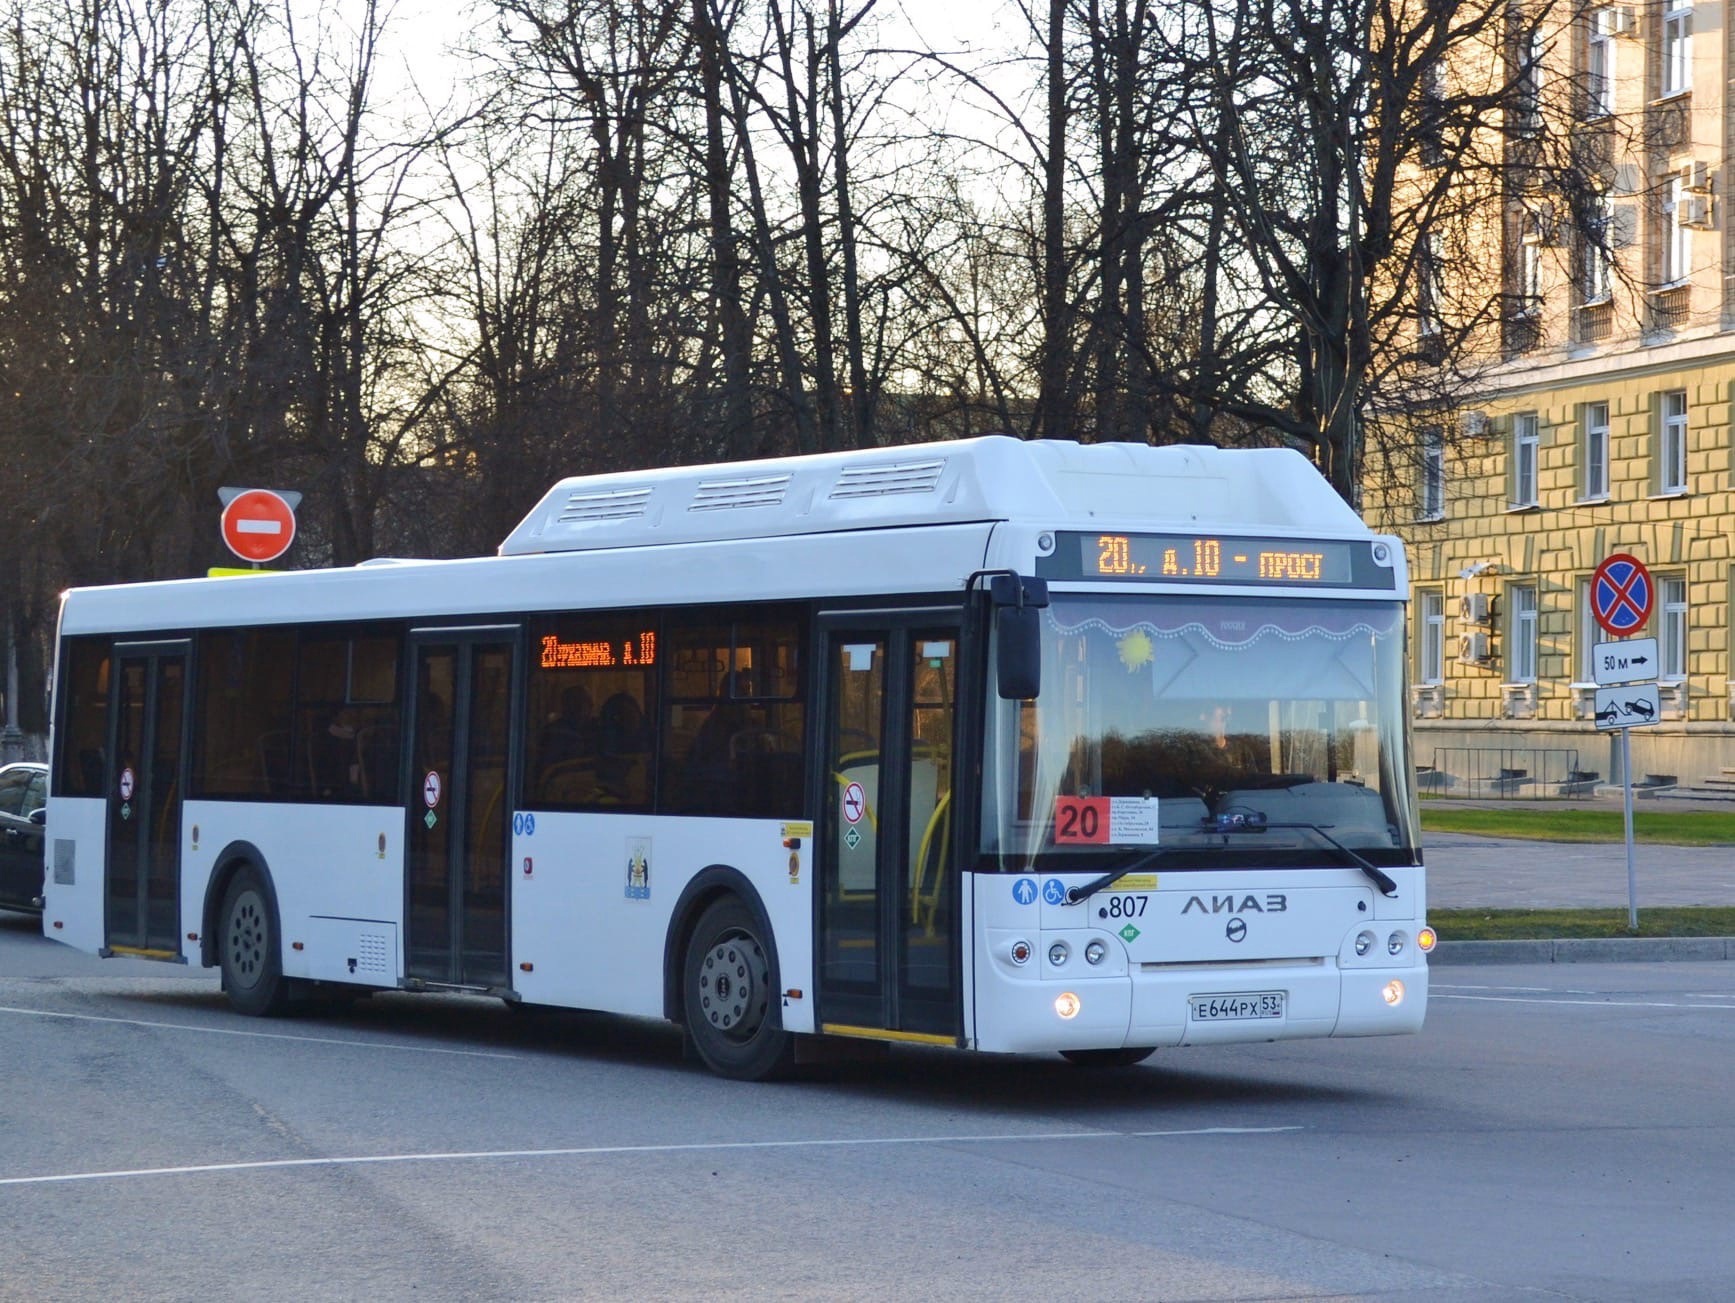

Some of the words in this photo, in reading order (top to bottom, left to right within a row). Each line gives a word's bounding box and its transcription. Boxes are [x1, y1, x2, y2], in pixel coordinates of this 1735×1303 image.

[1604, 655, 1615, 671] 50
[1060, 805, 1099, 838] 20
[1109, 896, 1148, 918] 807
[1181, 894, 1287, 915] ЛИАЗ
[1262, 996, 1276, 1010] 53
